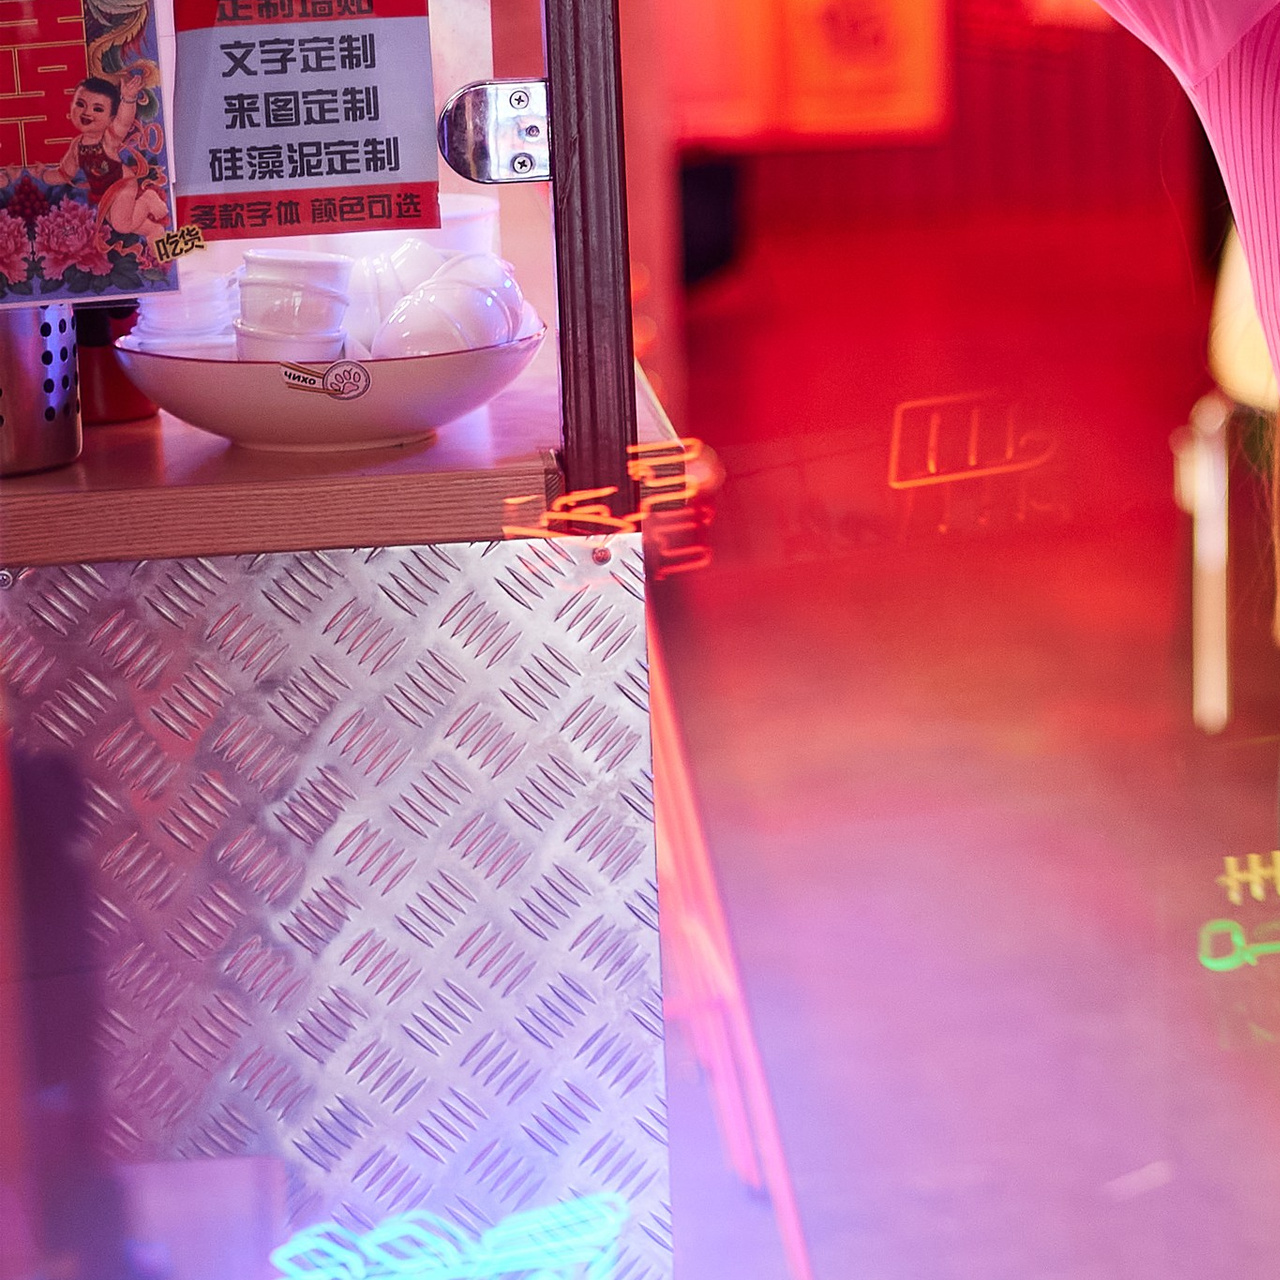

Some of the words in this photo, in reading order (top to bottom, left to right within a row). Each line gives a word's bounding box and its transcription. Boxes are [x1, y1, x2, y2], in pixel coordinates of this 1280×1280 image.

[219, 33, 376, 78] 文字定制
[223, 85, 380, 130] 来图定制
[208, 136, 400, 182] 硅藻泥定制
[190, 199, 301, 230] 多款字体
[310, 192, 422, 224] 颜色可选
[155, 227, 204, 261] 吃货
